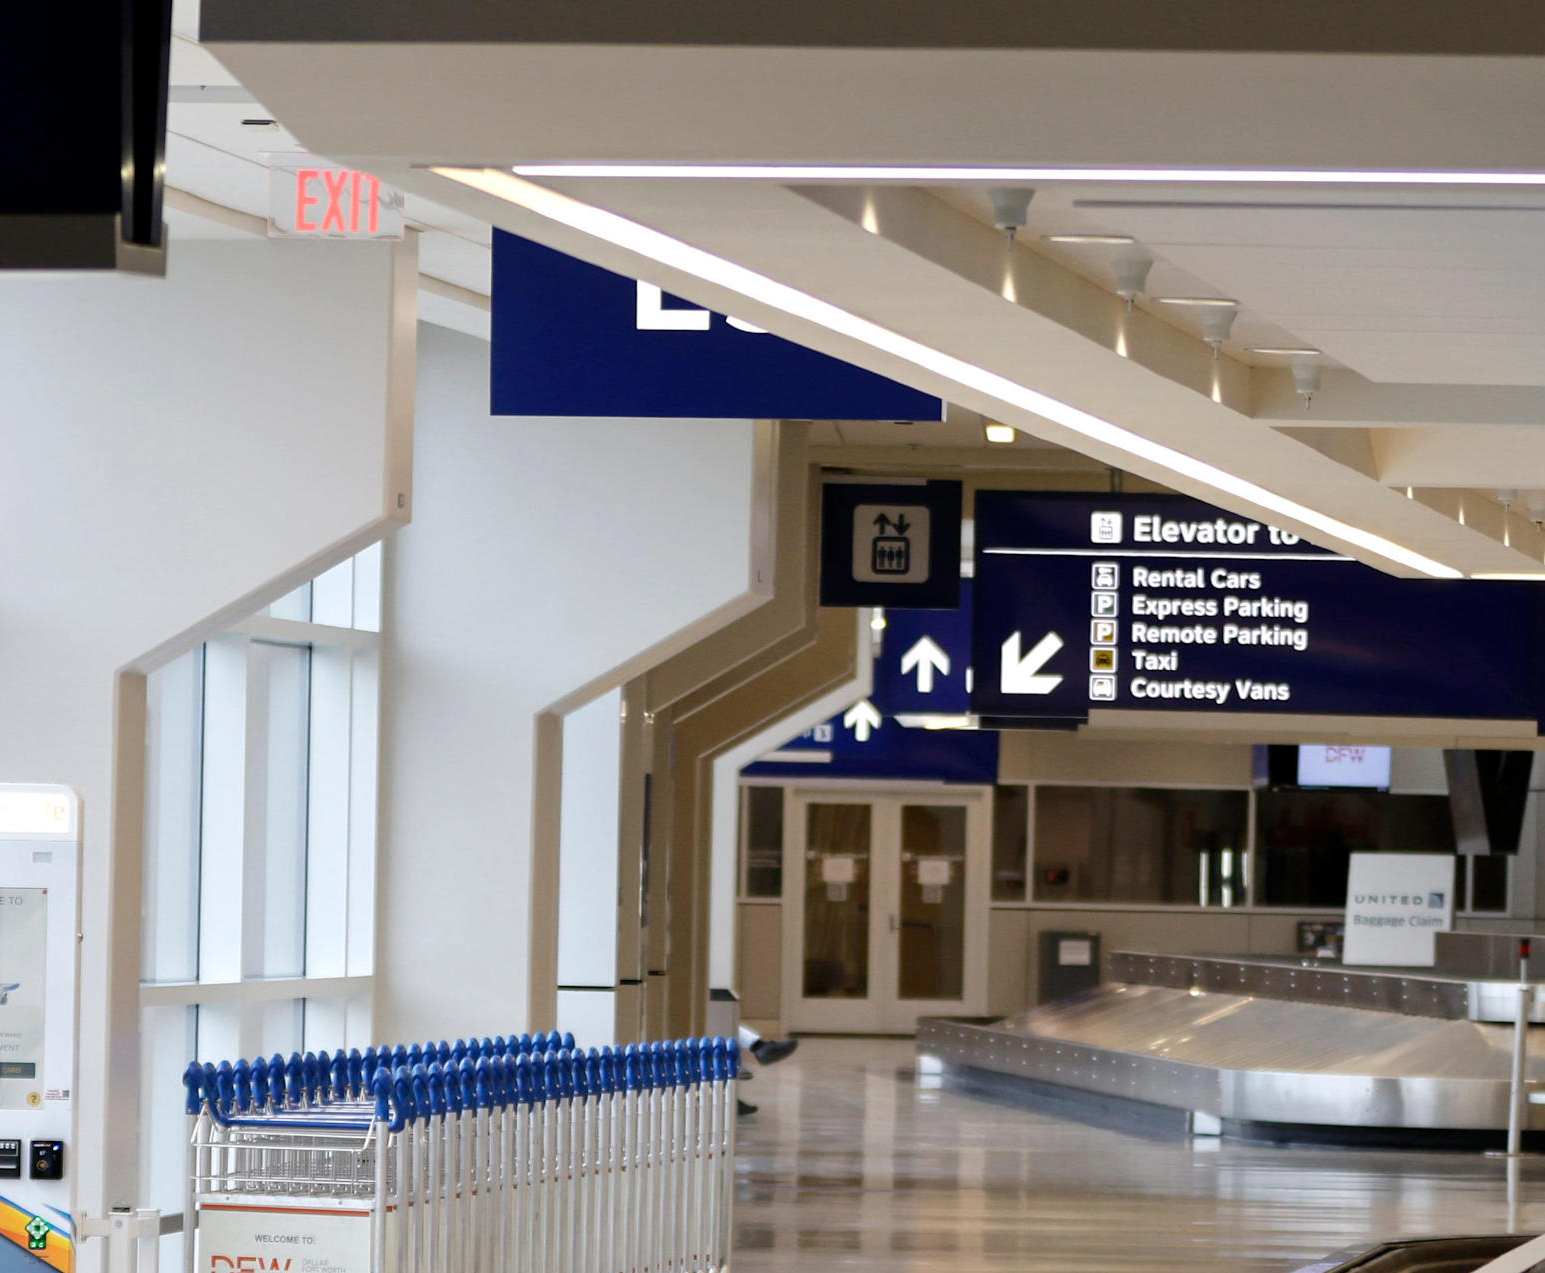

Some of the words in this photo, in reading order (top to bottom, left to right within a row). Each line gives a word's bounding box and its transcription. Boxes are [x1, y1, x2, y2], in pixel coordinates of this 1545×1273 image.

[295, 169, 381, 233] EXIT
[1133, 515, 1259, 545] Elevator
[1132, 566, 1204, 588] Rental
[1210, 568, 1261, 589] Cars
[1132, 594, 1218, 620] Express
[1223, 595, 1309, 623] Parking
[1131, 621, 1217, 644] Remote
[1223, 623, 1308, 651] Parking
[1131, 650, 1178, 671] Taxi
[1130, 676, 1230, 704] Courtesy
[1235, 679, 1290, 700] Vans
[1325, 745, 1365, 763] DFW
[9, 896, 23, 905] TO
[1355, 895, 1423, 906] UNITED
[1353, 915, 1405, 928] Baggage
[1408, 915, 1444, 927] Claim
[254, 1233, 299, 1244] WELCOME
[302, 1258, 328, 1266] DALLAS
